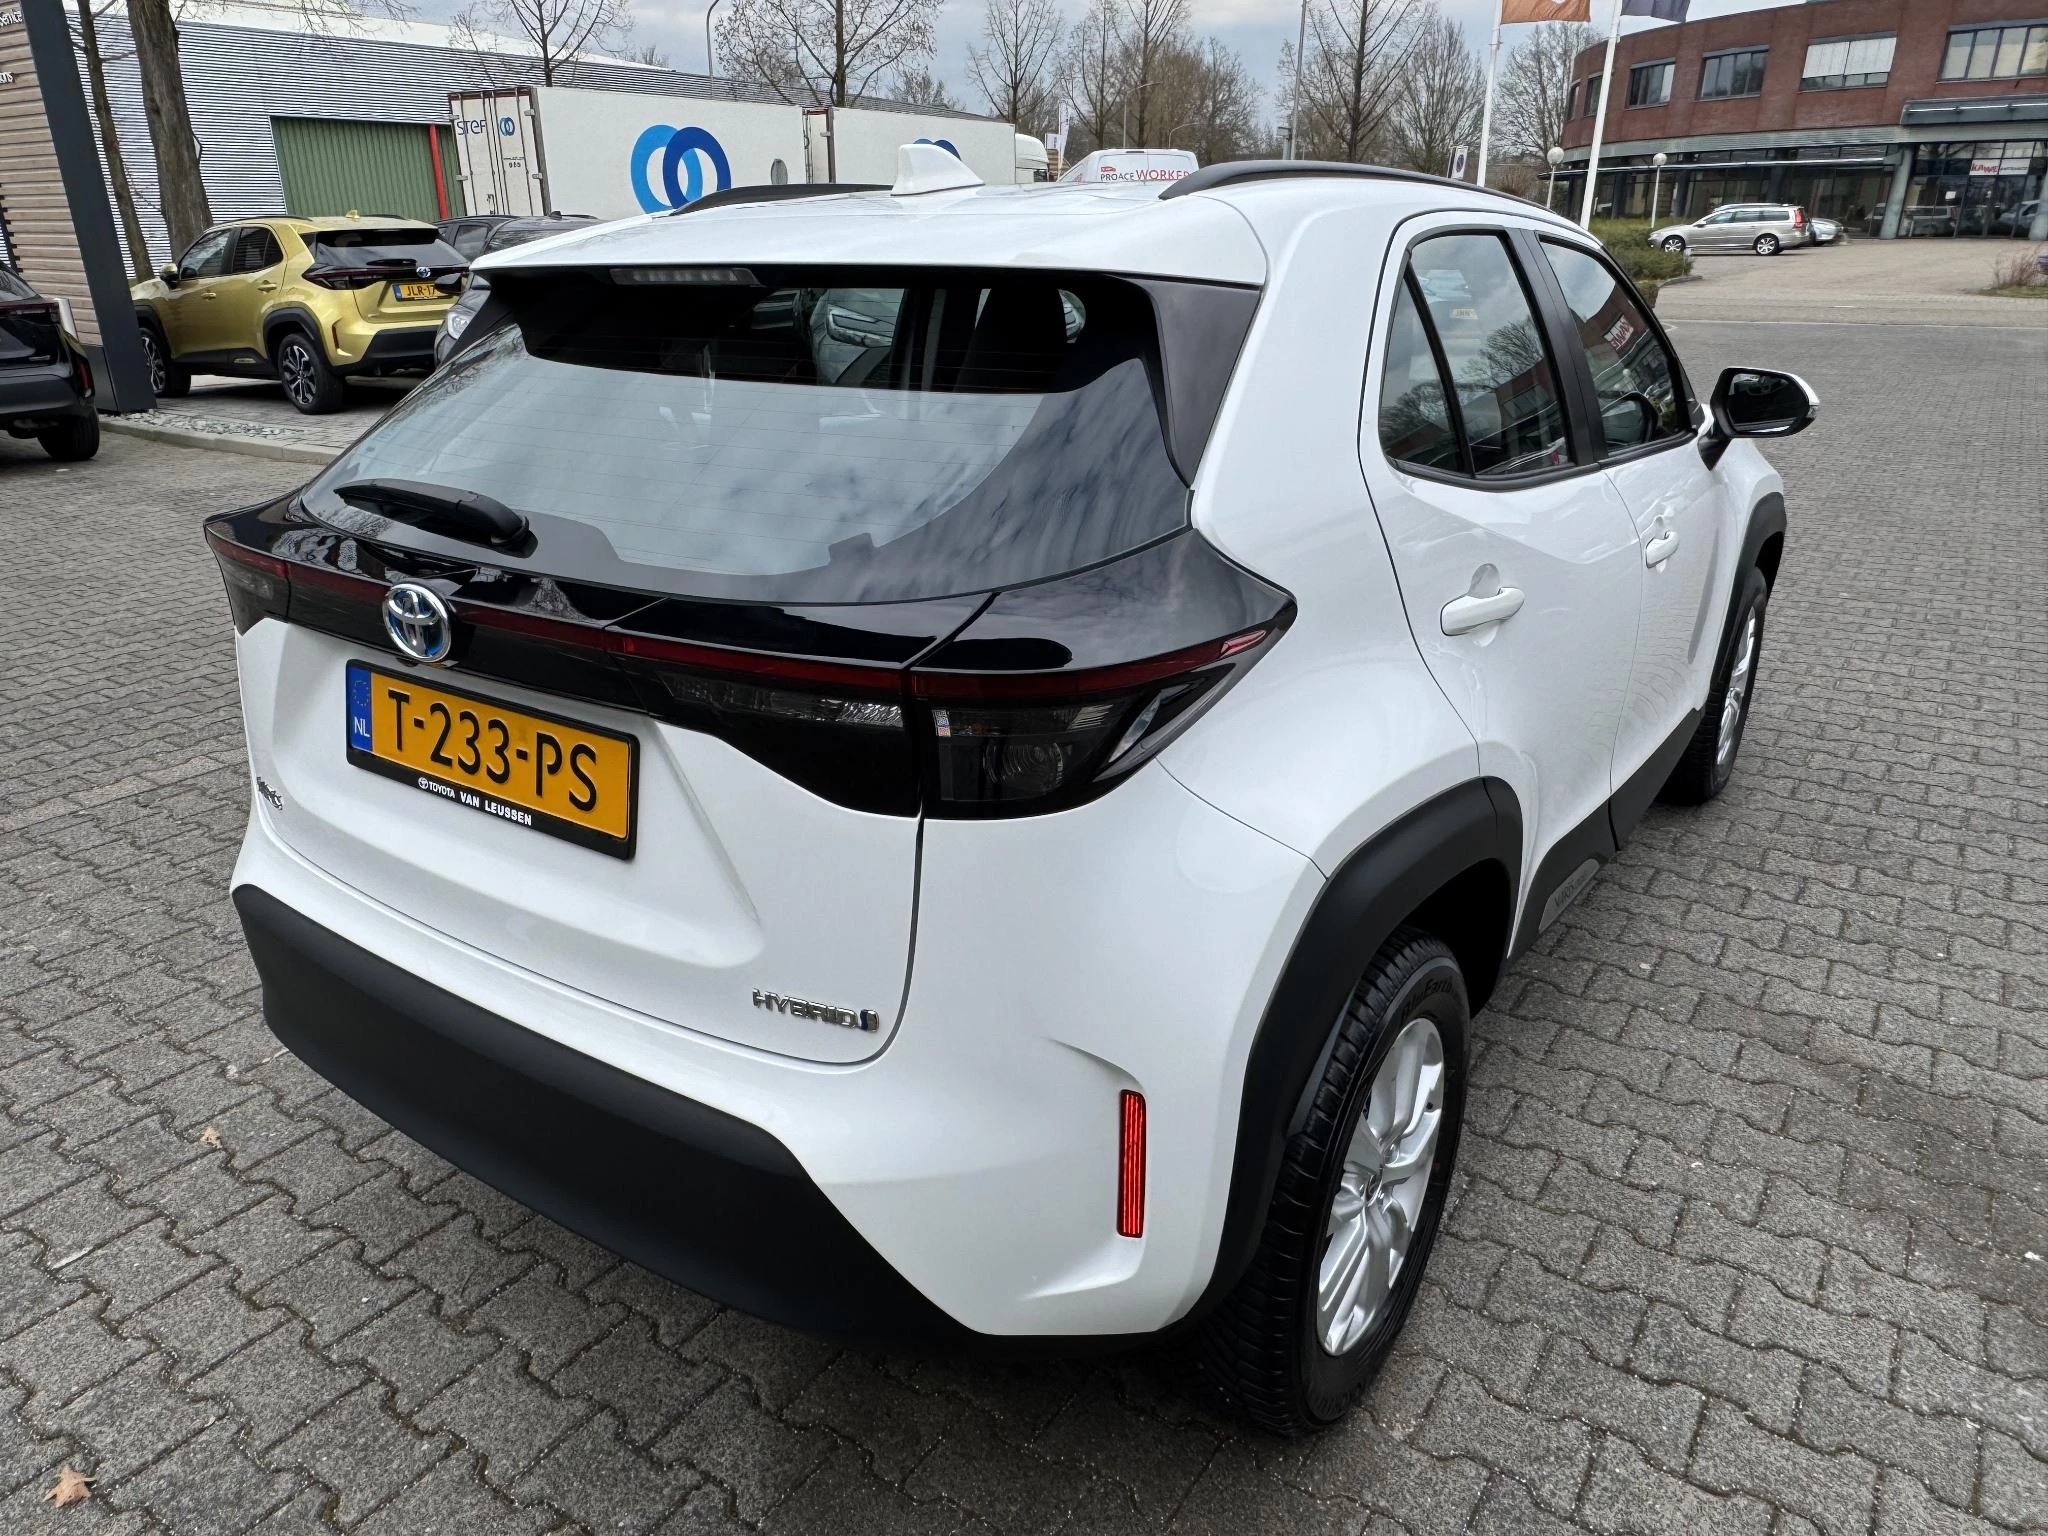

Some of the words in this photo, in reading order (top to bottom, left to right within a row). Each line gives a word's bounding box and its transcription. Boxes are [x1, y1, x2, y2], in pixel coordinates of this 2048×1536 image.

[1101, 172, 1134, 182] PROACE
[354, 717, 371, 739] NL
[388, 689, 597, 812] T-233-PS
[429, 781, 455, 799] TOYOTA
[460, 791, 480, 808] VAN
[485, 800, 532, 826] LEUSSEN
[752, 988, 859, 1029] HYBRID
